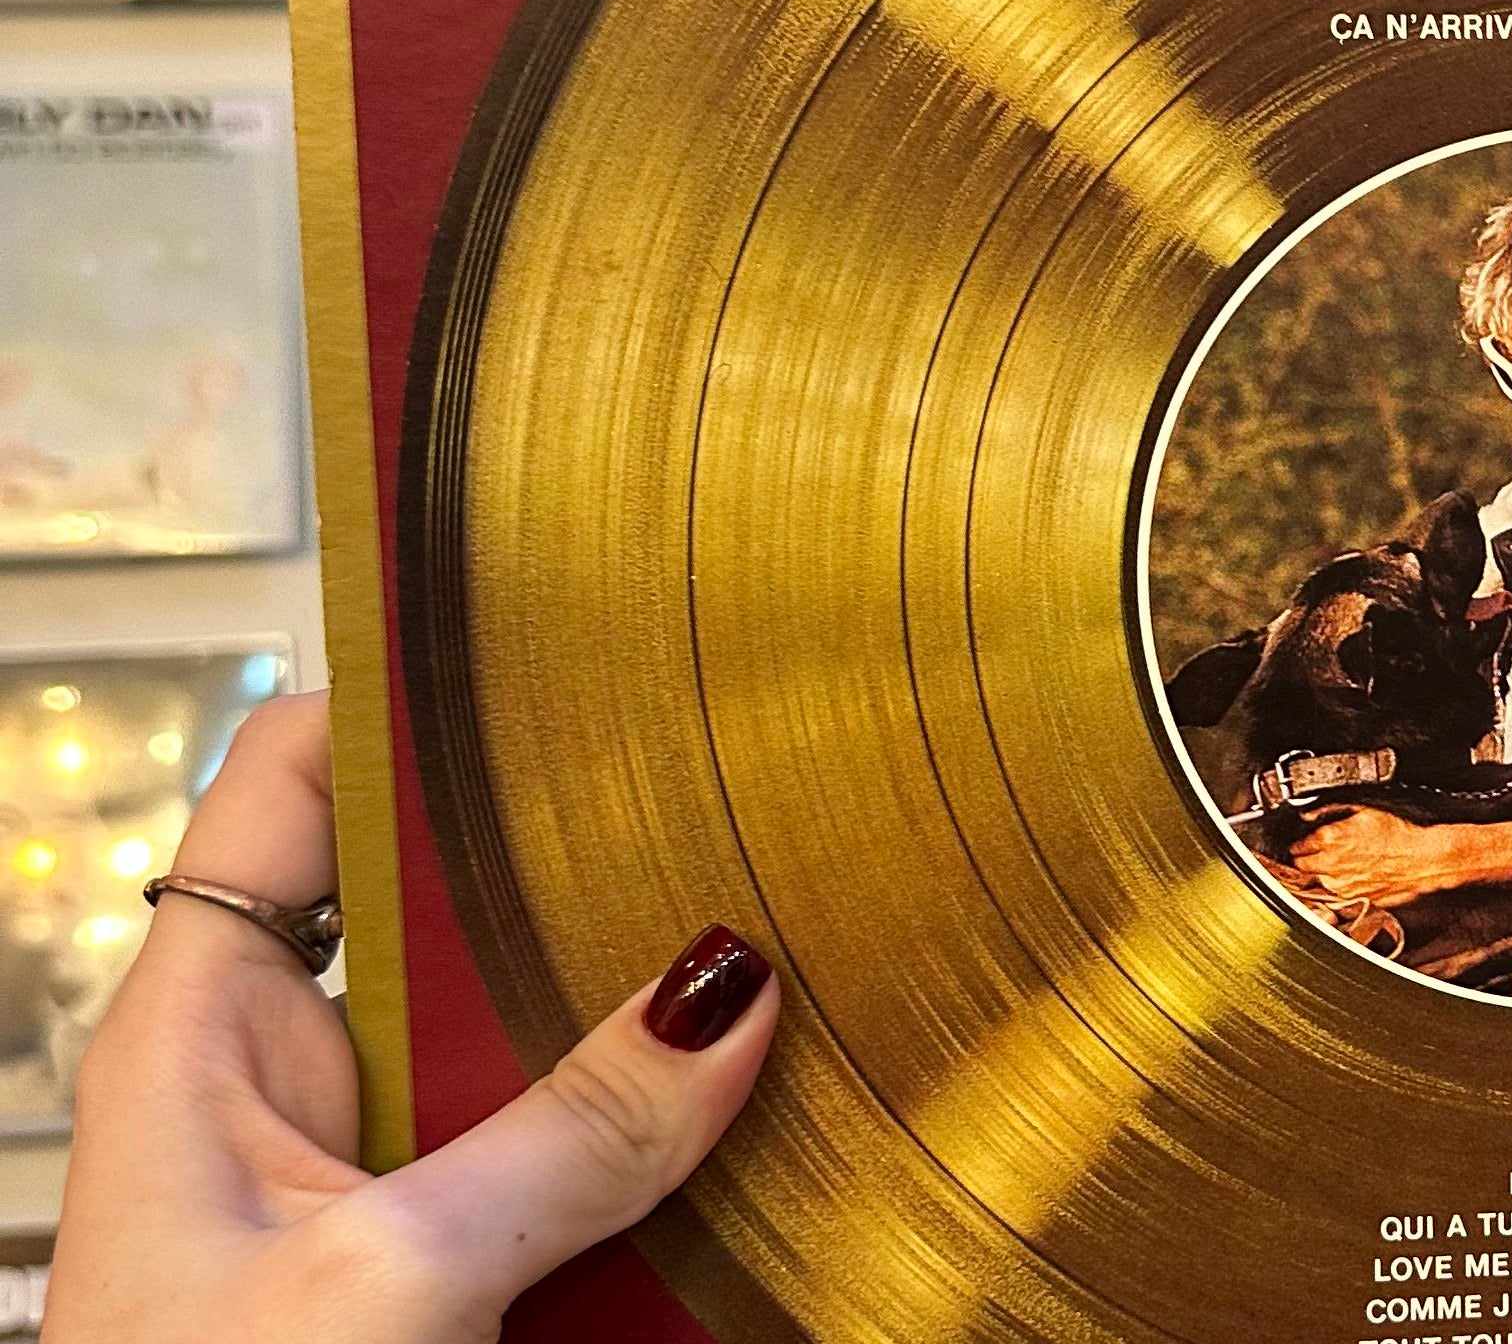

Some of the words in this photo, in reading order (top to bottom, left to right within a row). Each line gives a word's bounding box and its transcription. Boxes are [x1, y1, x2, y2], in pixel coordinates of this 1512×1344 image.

[1330, 13, 1375, 46] ÇA
[1380, 1215, 1434, 1242] QUI
[1446, 1214, 1467, 1238] A
[1374, 1255, 1454, 1282] LOVE
[1365, 1294, 1483, 1324] COMME
